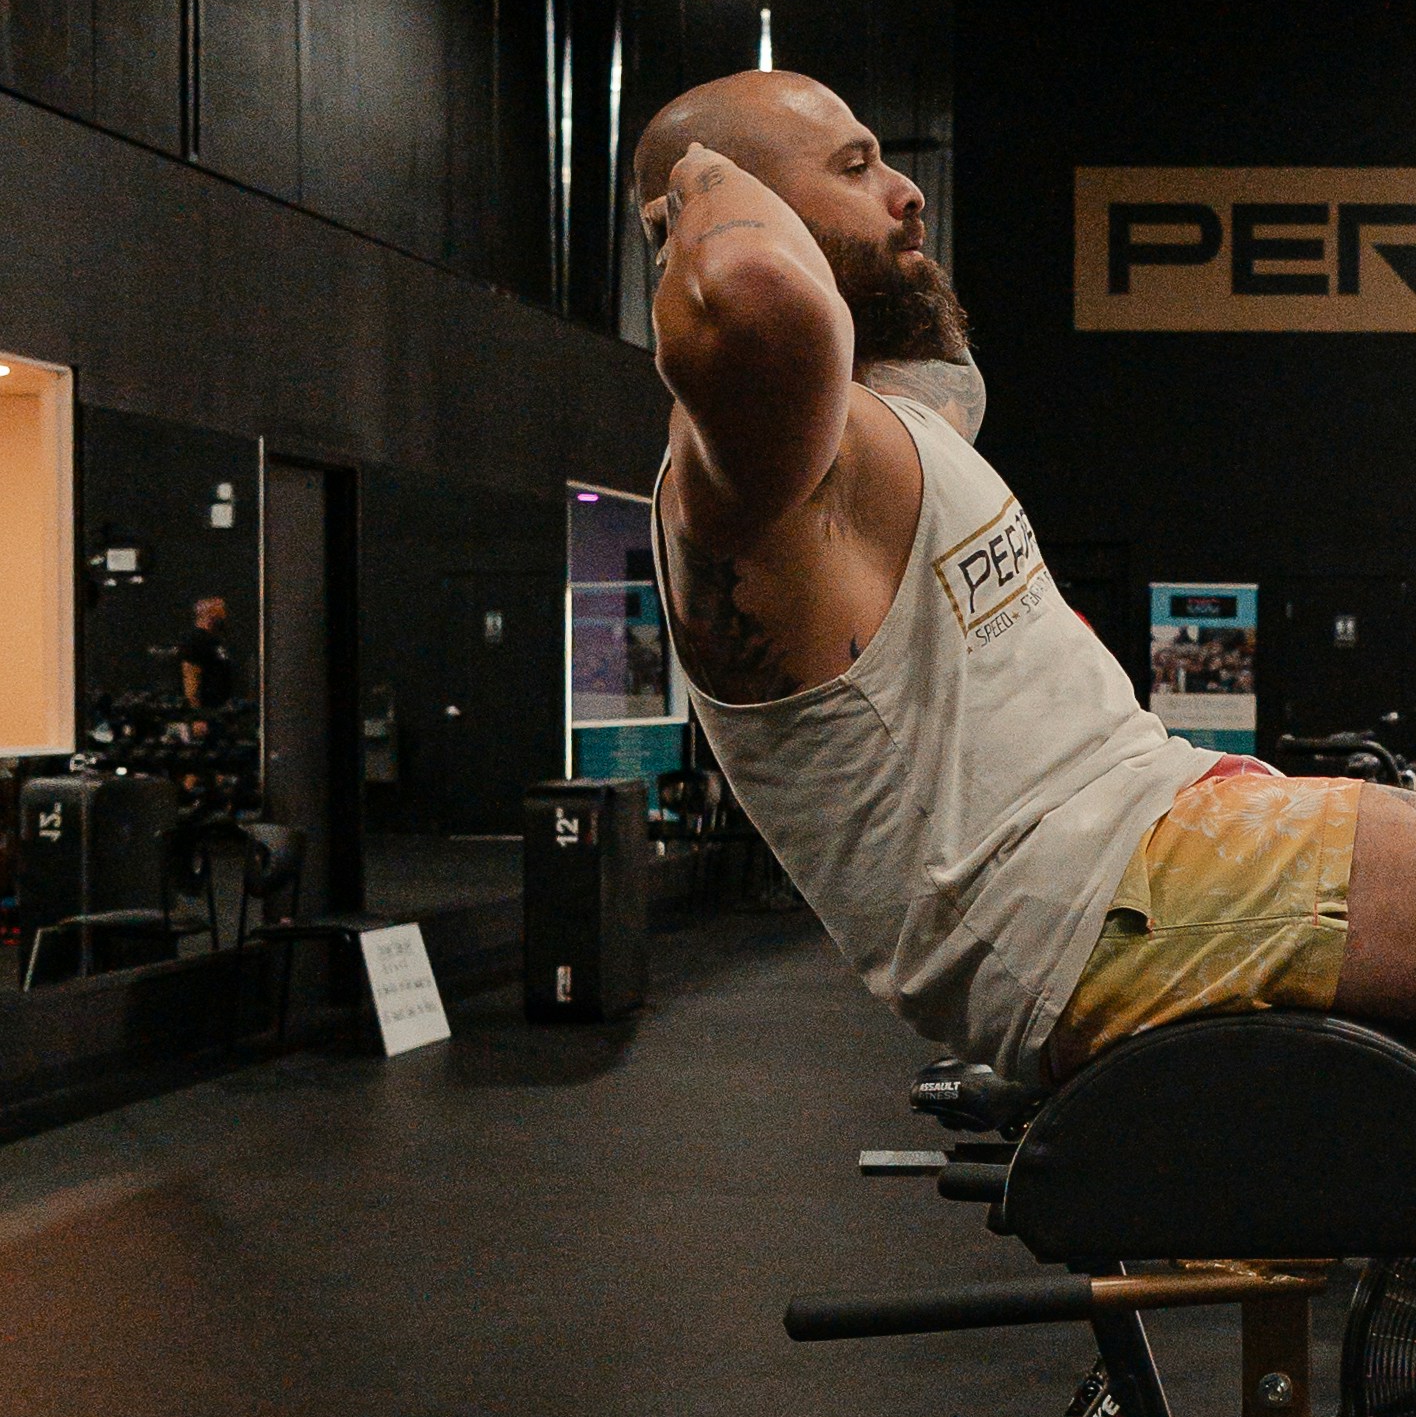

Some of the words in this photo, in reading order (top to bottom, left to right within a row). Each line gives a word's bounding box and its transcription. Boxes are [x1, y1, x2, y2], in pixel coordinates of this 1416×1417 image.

[975, 612, 1014, 647] SPEED
[919, 1081, 961, 1092] ASSAULT
[918, 1091, 959, 1100] FITNESS
